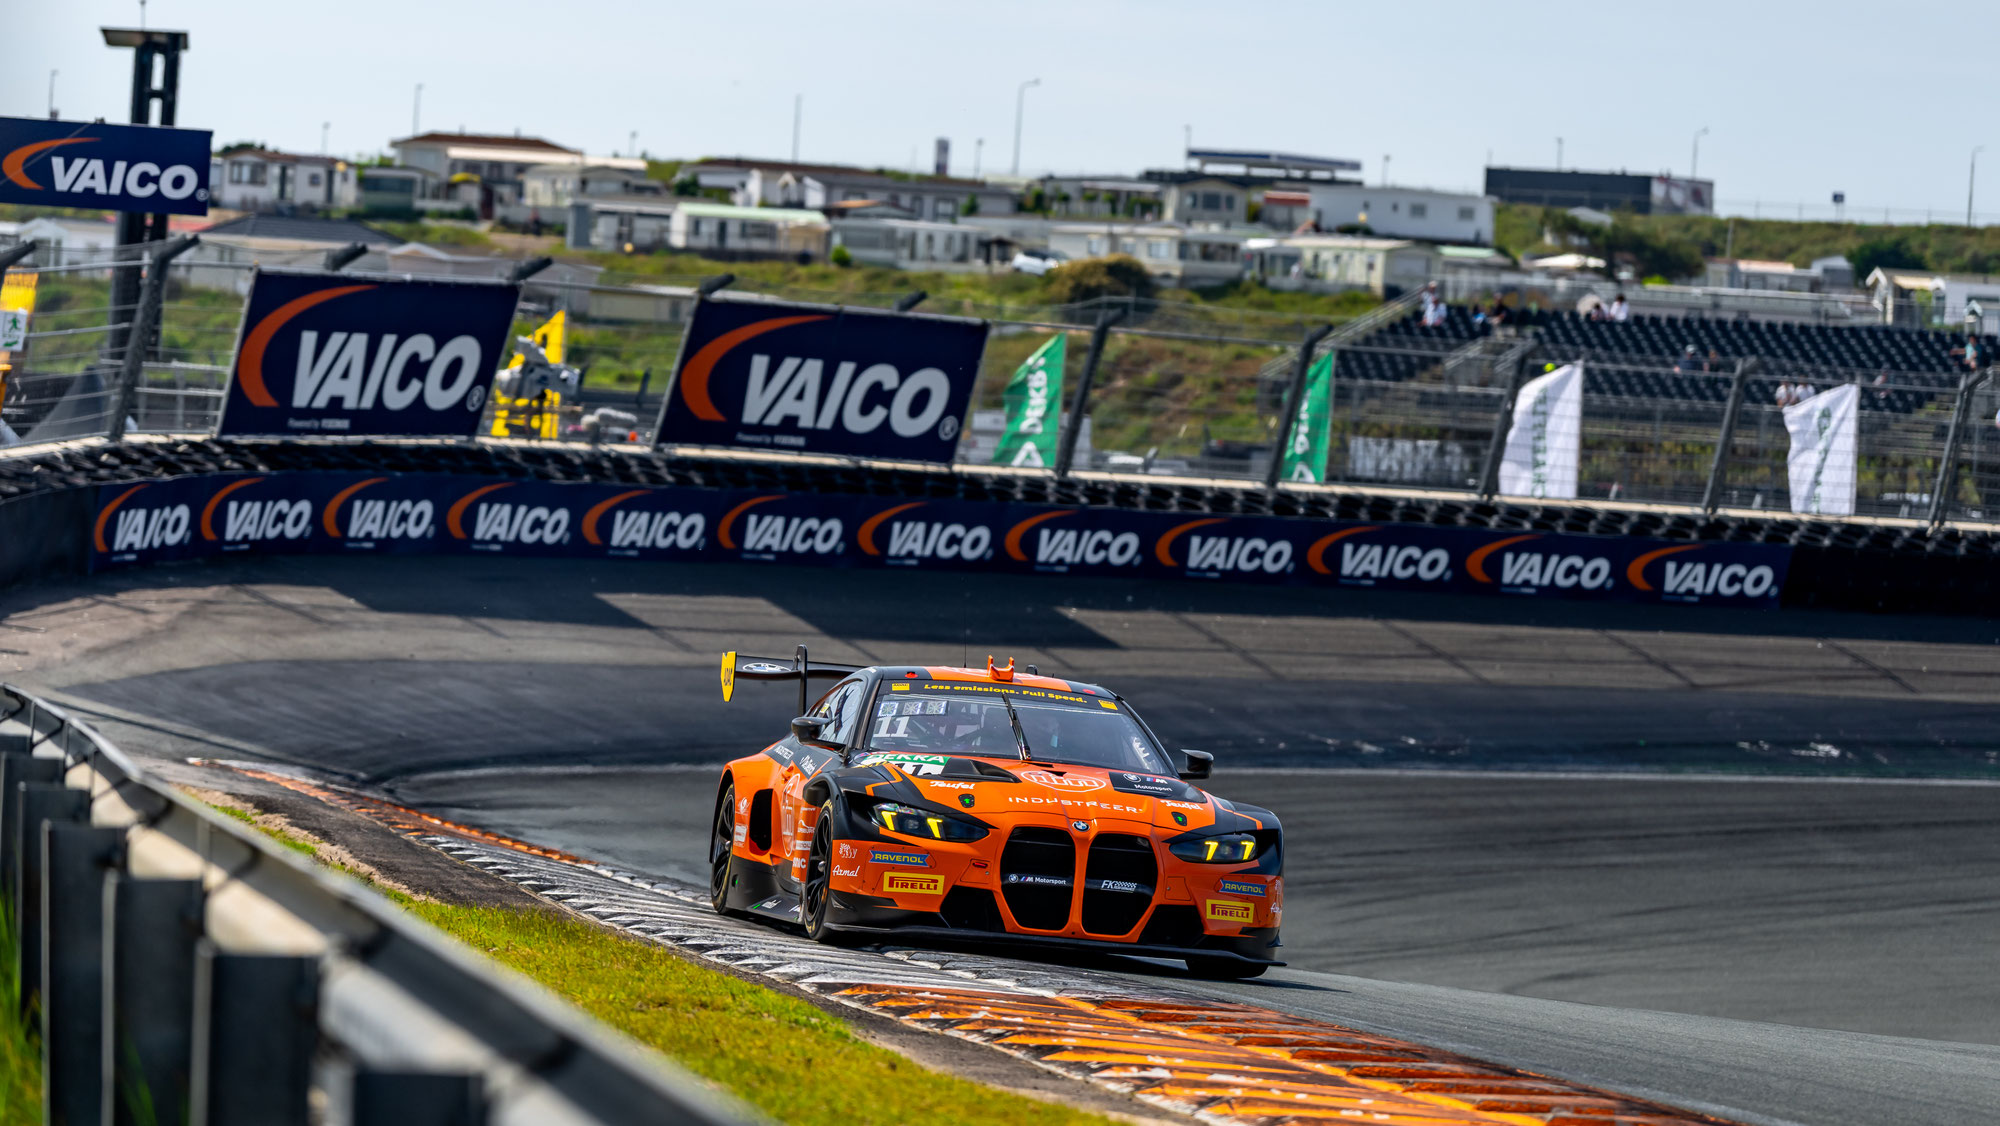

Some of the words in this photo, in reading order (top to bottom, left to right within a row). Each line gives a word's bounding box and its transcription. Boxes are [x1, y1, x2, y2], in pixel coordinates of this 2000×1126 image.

[52, 156, 198, 199] VAICO
[292, 330, 481, 410] VAICO
[743, 355, 950, 436] VAICO
[114, 505, 188, 551] VAICO
[225, 500, 310, 541] VAICO
[347, 498, 432, 538] VAICO
[474, 503, 568, 545] VAICO
[611, 510, 705, 549] VAICO
[744, 514, 842, 553] VAICO
[888, 522, 991, 559] VAICO
[1037, 528, 1139, 565] VAICO
[1188, 536, 1292, 572] VAICO
[1342, 543, 1449, 579] VAICO
[1502, 552, 1610, 588] VAICO
[1664, 561, 1773, 596] VAICO
[954, 685, 1020, 695] emissions.
[1022, 689, 1045, 698] Full
[1048, 692, 1088, 704] Speed.
[873, 716, 910, 738] 11
[867, 754, 945, 764] DEKRA
[929, 780, 976, 790] Teufel
[1133, 783, 1173, 792] Motorsport
[1008, 797, 1139, 814] INDUSTREER
[1160, 799, 1204, 811] Teufel
[832, 865, 861, 877] Armal
[874, 853, 924, 864] RAVENOL
[888, 875, 939, 891] PIRELLI
[1034, 876, 1067, 885] Motorsport
[1101, 879, 1116, 889] FK
[1224, 883, 1264, 894] RAVENOL
[1210, 903, 1251, 919] PIRELLI
